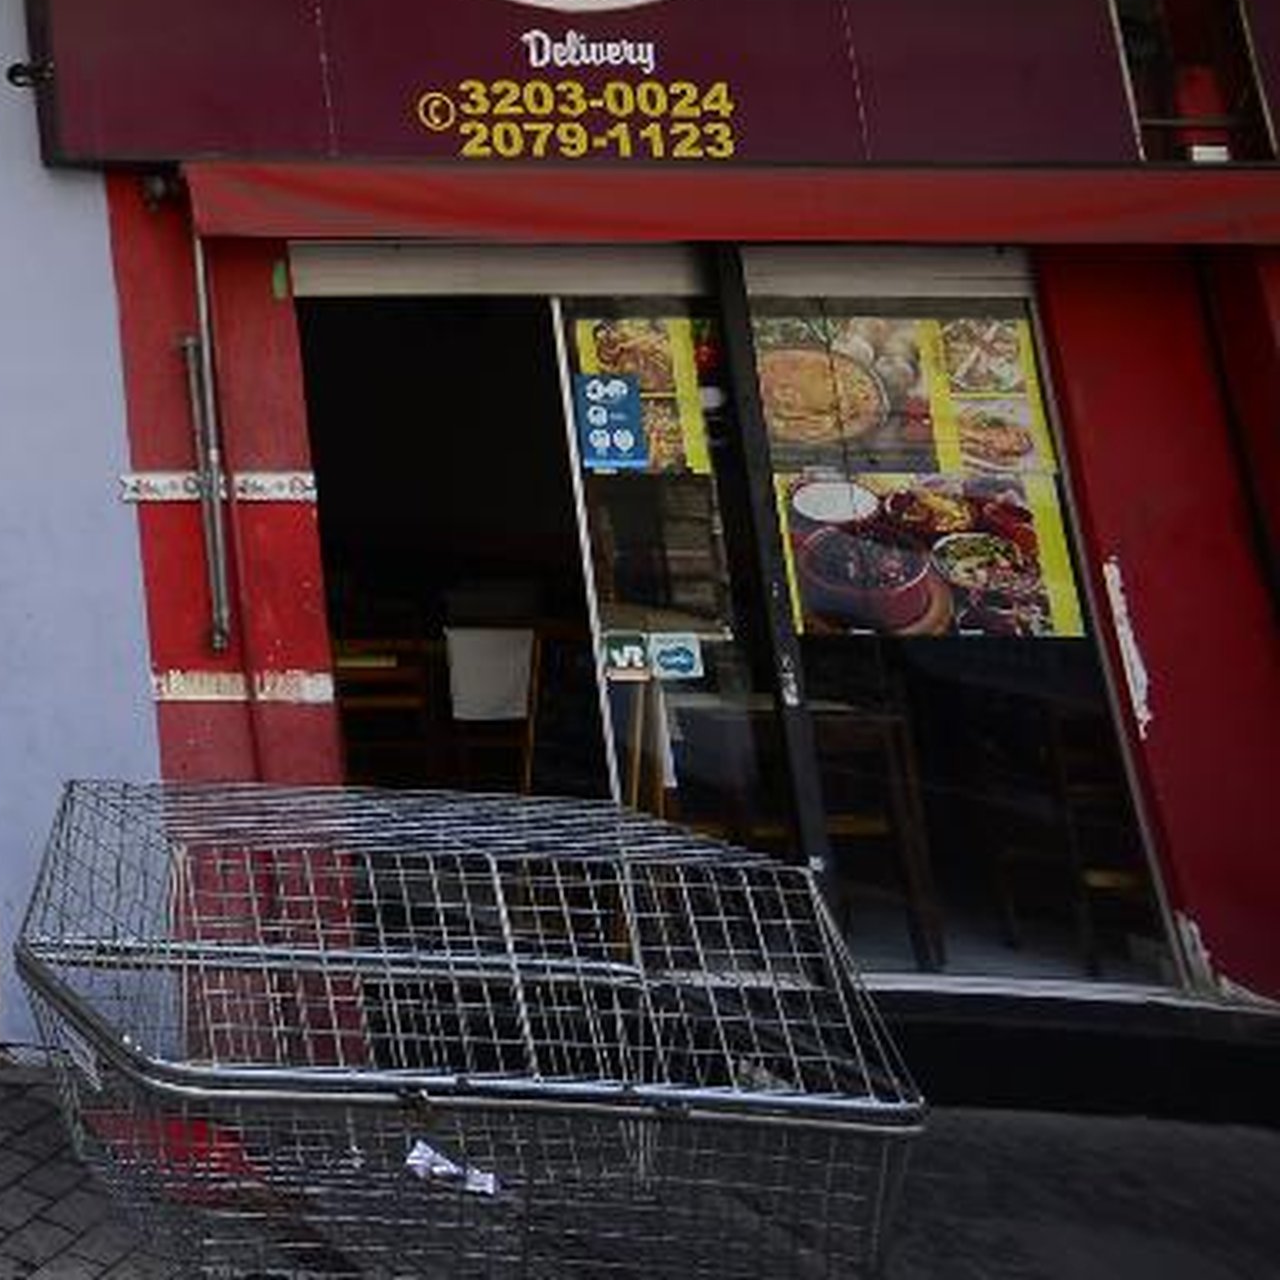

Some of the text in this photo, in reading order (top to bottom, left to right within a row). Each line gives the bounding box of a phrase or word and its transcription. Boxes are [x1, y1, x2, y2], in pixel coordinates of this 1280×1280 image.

[521, 29, 656, 74] Delivery
[458, 79, 735, 118] 3203-0024
[458, 121, 735, 158] 2079-1123
